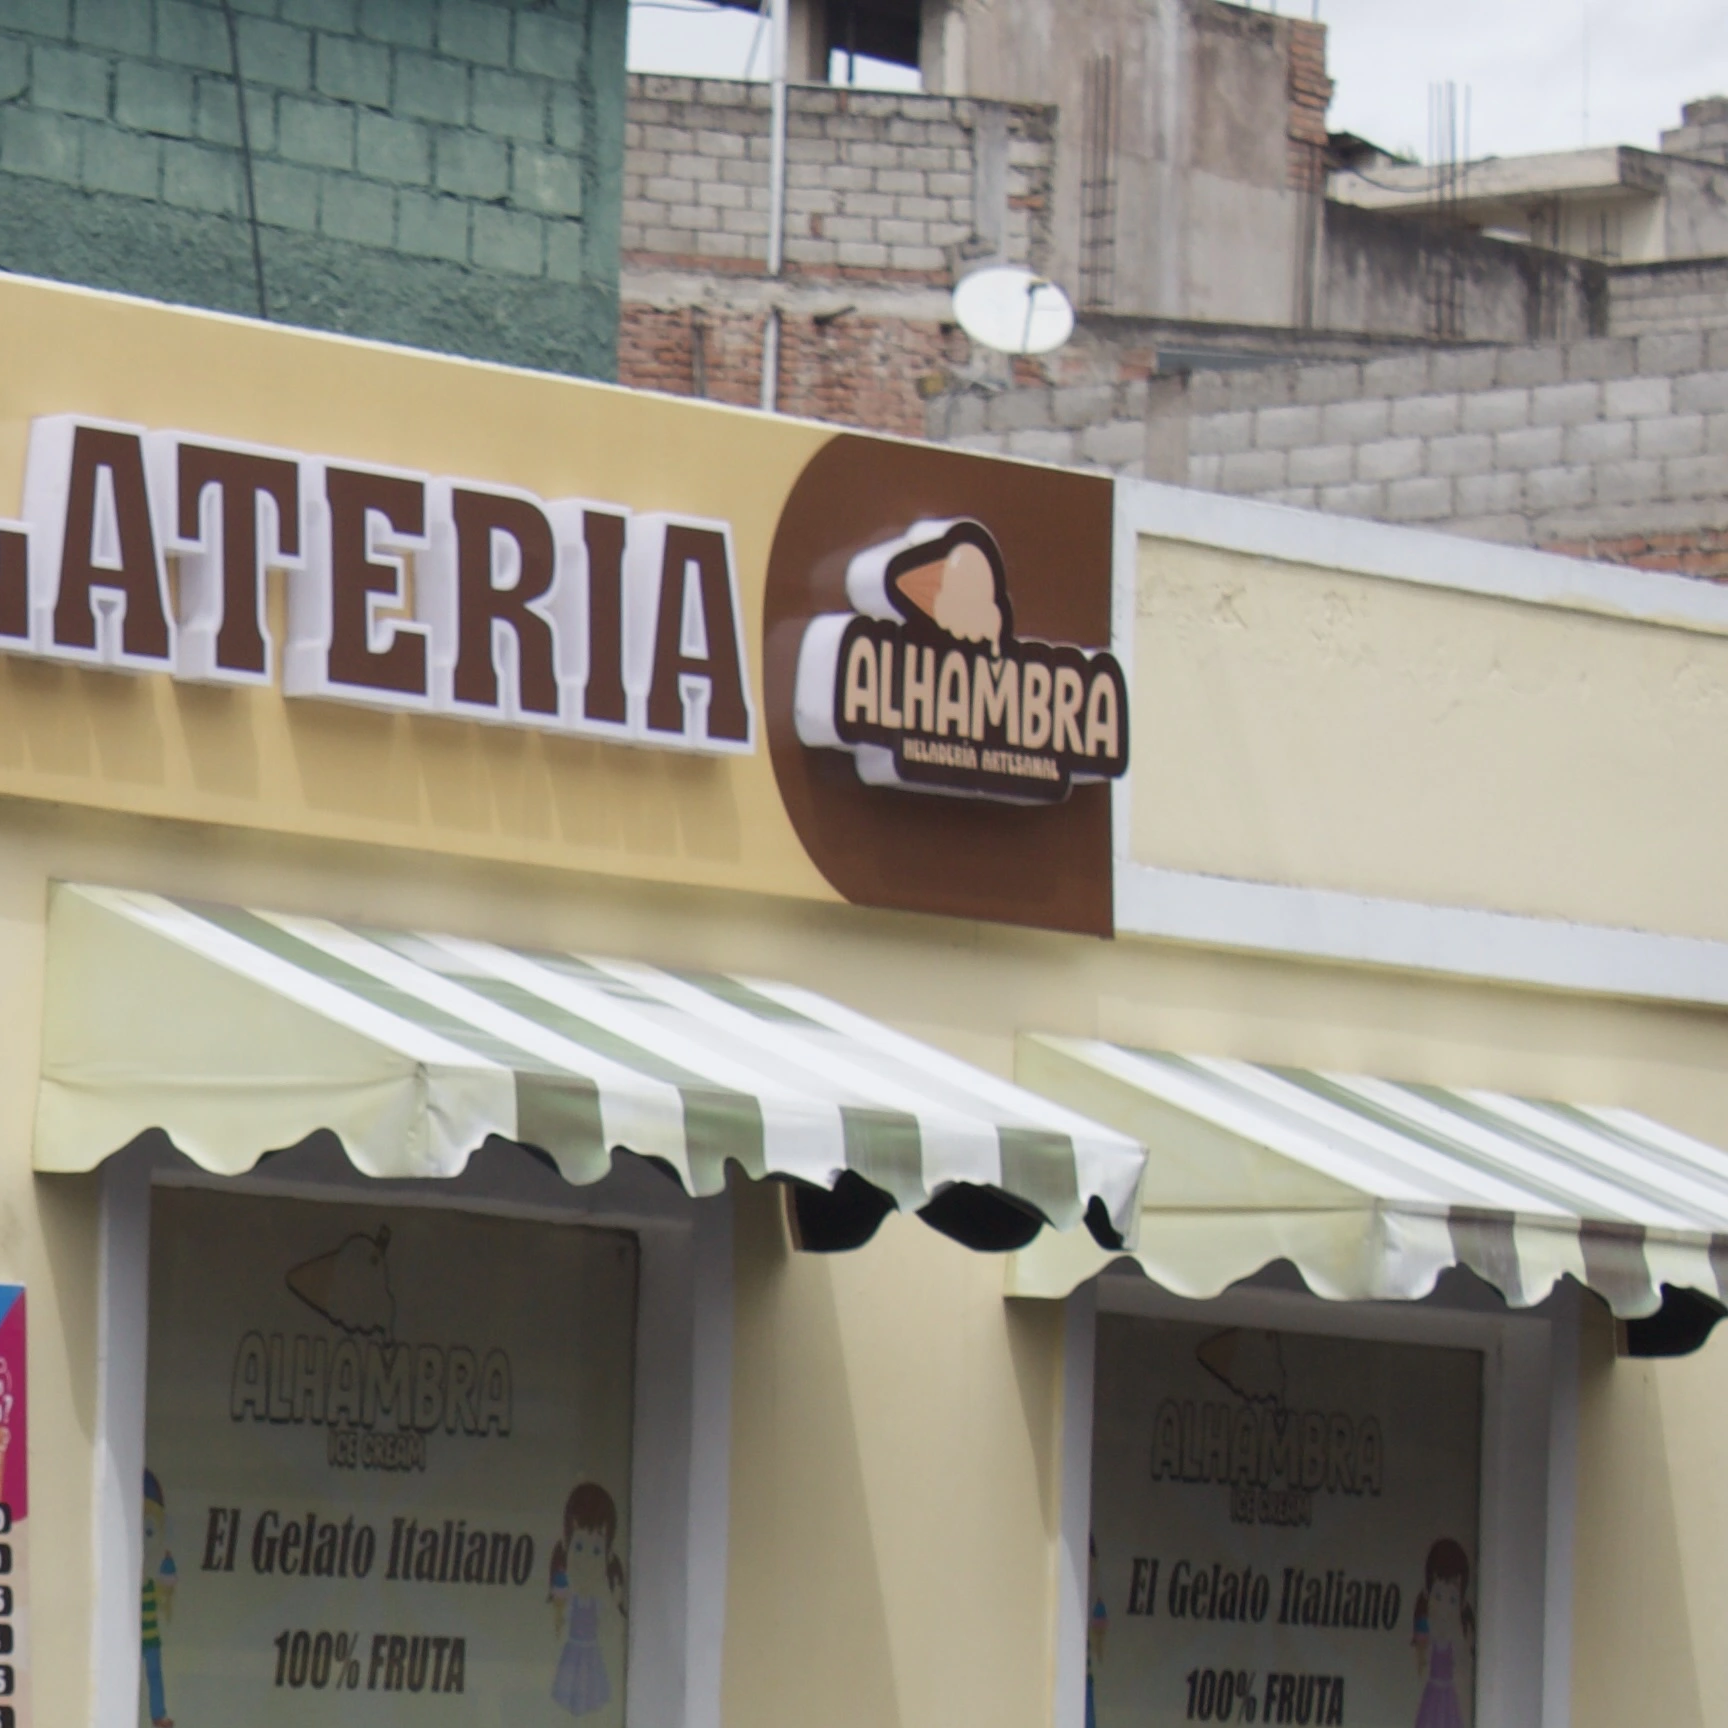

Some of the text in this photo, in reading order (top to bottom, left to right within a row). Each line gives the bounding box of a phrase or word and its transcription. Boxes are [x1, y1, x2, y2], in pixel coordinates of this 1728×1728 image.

[844, 635, 1119, 759] ALHAMBRA
[230, 1330, 512, 1437] ALHAMBRA
[362, 1433, 427, 1471] CREAM
[1150, 1397, 1383, 1497] ALHAMBRA
[201, 1507, 535, 1586] El Gelato Italiano
[1127, 1557, 1401, 1631] El Gelato Italiano
[274, 1629, 466, 1694] 100% FRUTA
[1186, 1668, 1345, 1728] 100% FRUTA
